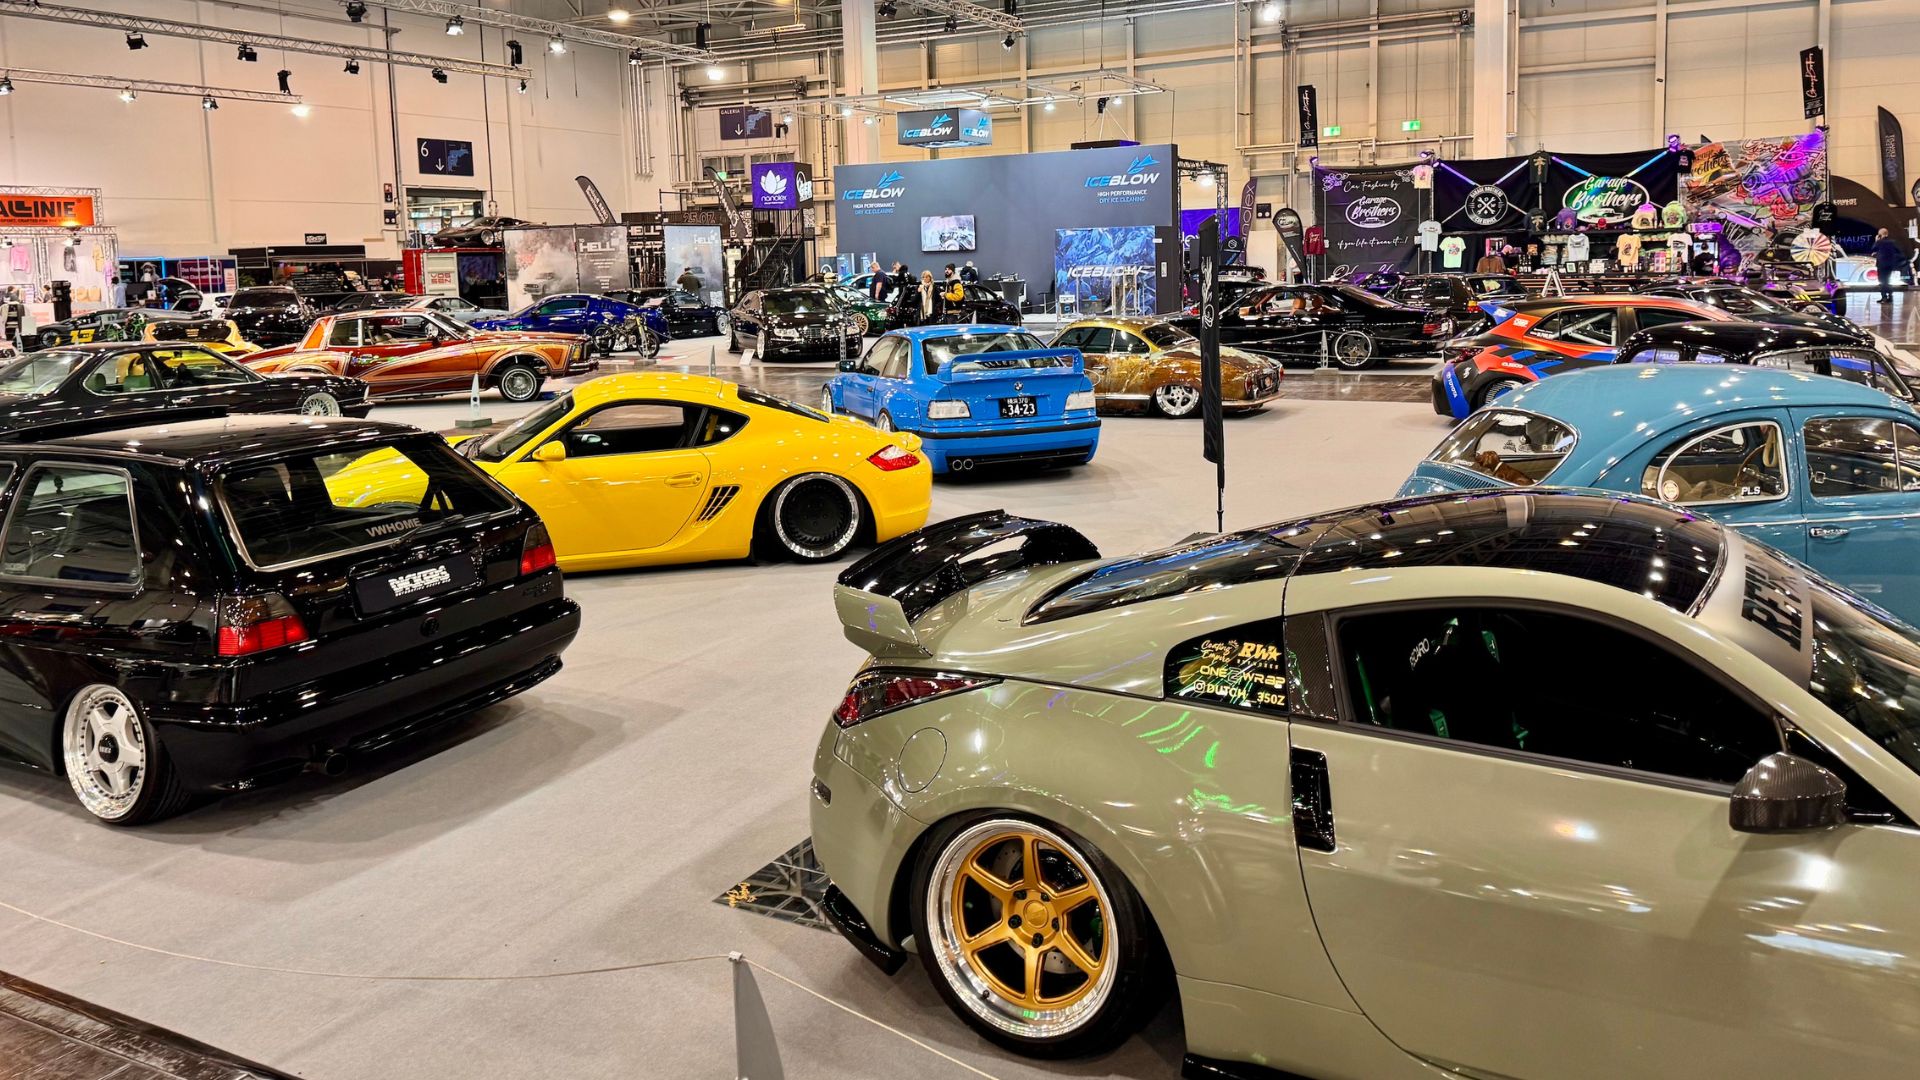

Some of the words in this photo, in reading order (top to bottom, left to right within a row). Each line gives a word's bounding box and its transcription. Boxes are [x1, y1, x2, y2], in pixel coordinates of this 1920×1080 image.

[903, 126, 953, 139] ICEBLOW
[962, 127, 990, 138] ICEBLOW
[420, 141, 429, 157] 6
[1084, 172, 1161, 188] ICEBLOW
[1584, 176, 1628, 191] Garage
[842, 187, 905, 200] ICEBLOW
[1572, 191, 1642, 211] Brothers
[1351, 204, 1397, 220] Brothers
[1067, 265, 1142, 278] ICEBLOW
[1448, 378, 1459, 399] TOYOTA
[1007, 403, 1036, 416] 34-23
[1740, 485, 1762, 496] PLS
[365, 517, 422, 538] VWHOME
